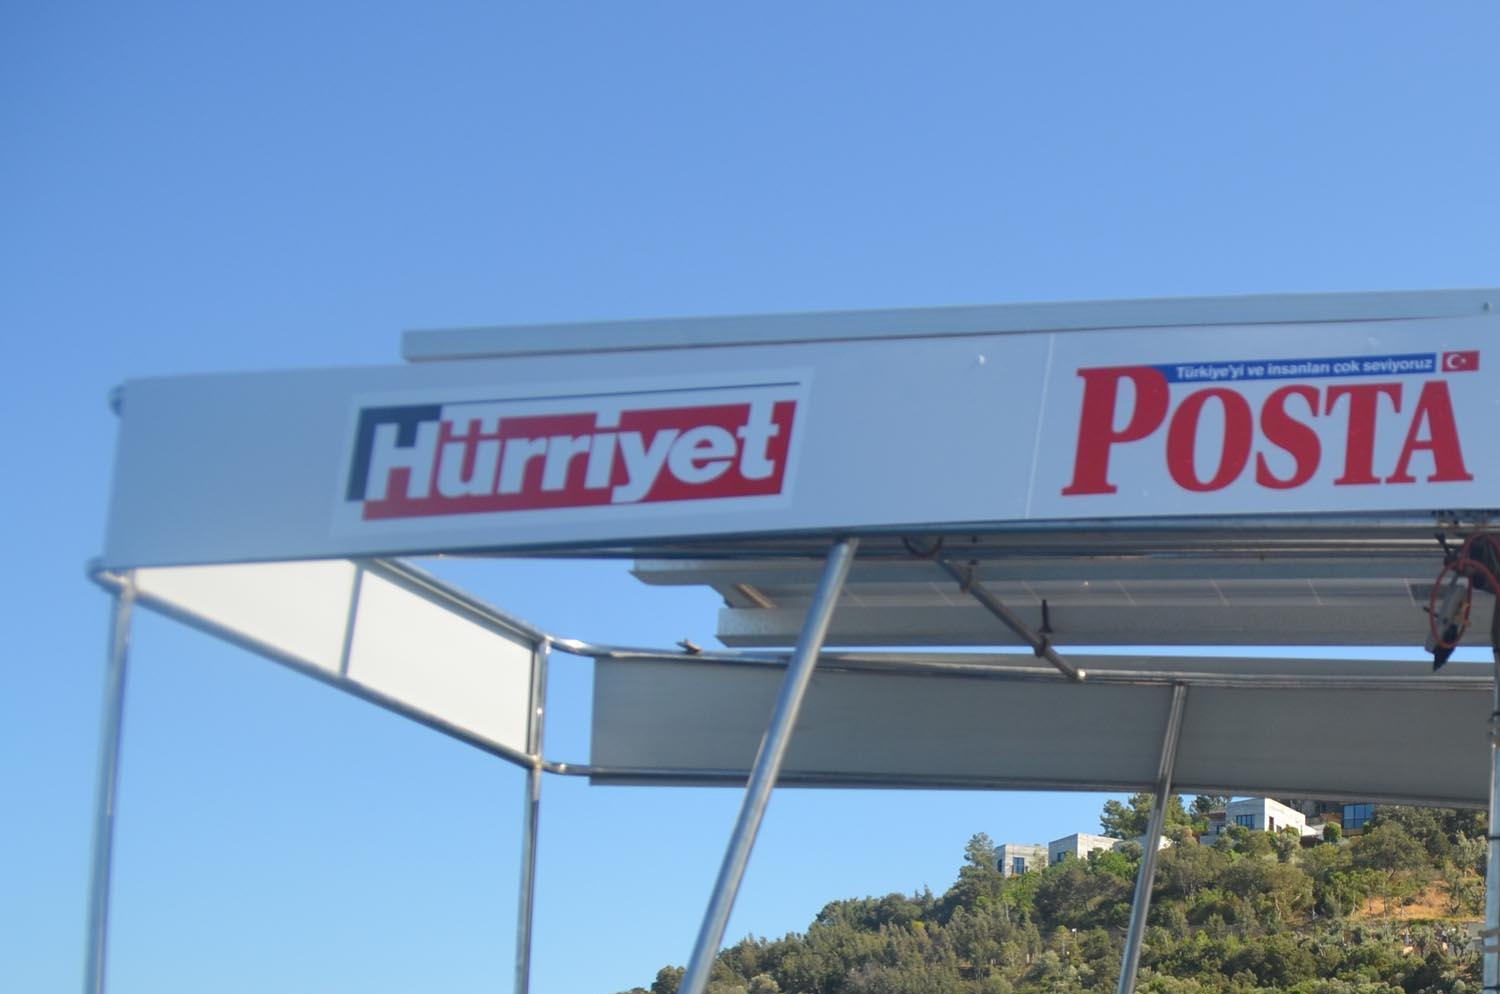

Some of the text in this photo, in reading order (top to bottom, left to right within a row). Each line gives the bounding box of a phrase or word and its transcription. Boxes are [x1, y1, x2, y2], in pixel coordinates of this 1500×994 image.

[1247, 366, 1265, 377] ve
[1362, 357, 1433, 373] seviyoruz
[363, 401, 780, 504] Hürriyet
[1061, 364, 1475, 496] POSTA
